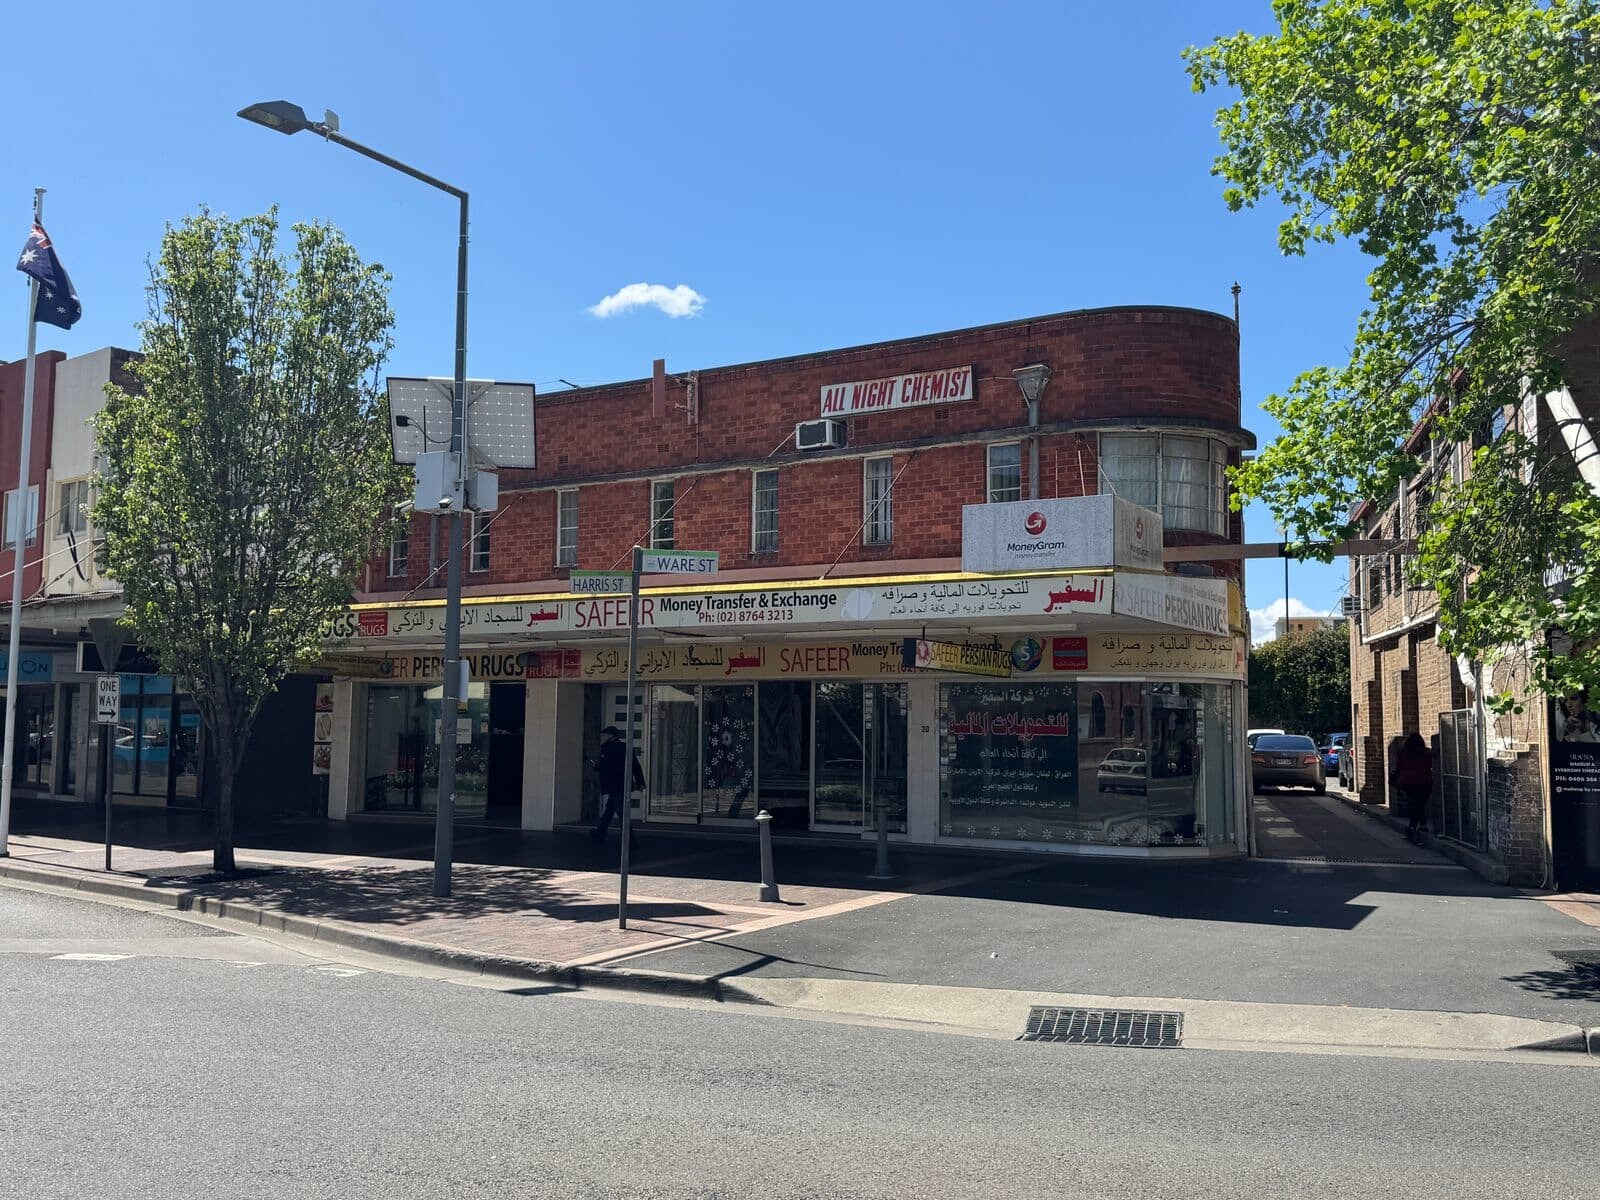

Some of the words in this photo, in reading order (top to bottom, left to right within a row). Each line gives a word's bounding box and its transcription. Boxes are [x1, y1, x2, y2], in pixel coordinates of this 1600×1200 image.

[823, 387, 846, 413] ALL
[851, 380, 896, 410] NIGHT
[901, 370, 970, 403] CHEMIST
[1007, 541, 1065, 552] MoneyGram
[657, 557, 696, 571] WARE
[698, 558, 715, 572] ST
[573, 578, 610, 592] HARRIS
[612, 578, 624, 591] ST
[931, 584, 964, 602] المالية
[967, 581, 1029, 600] للتحويلات
[1043, 578, 1104, 612] السفير
[575, 598, 655, 628] SAFER
[660, 598, 704, 614] Money
[704, 594, 757, 610] Transfer
[758, 594, 769, 608] &
[771, 591, 837, 609] Exchange
[1164, 593, 1205, 629] PERSIAN
[484, 605, 523, 627] للسجاد
[527, 604, 563, 627] السفير
[699, 612, 715, 623] Ph:
[717, 611, 736, 624] (02)
[739, 610, 765, 622] 8764
[767, 609, 793, 621] 3213
[359, 624, 386, 636] RUGS
[725, 647, 766, 675] السفير
[780, 647, 850, 673] SAFEER
[852, 644, 889, 659] Money
[931, 642, 959, 664] SAFEER
[960, 647, 991, 667] PERSIAN
[992, 652, 1012, 670] RUGS
[481, 654, 524, 677] RUGS
[585, 651, 620, 677] التركي
[880, 661, 896, 673] Ph:
[100, 681, 116, 692] ONE
[99, 696, 117, 707] WAY
[921, 725, 930, 733] 20
[992, 711, 1069, 741] للتحويلات
